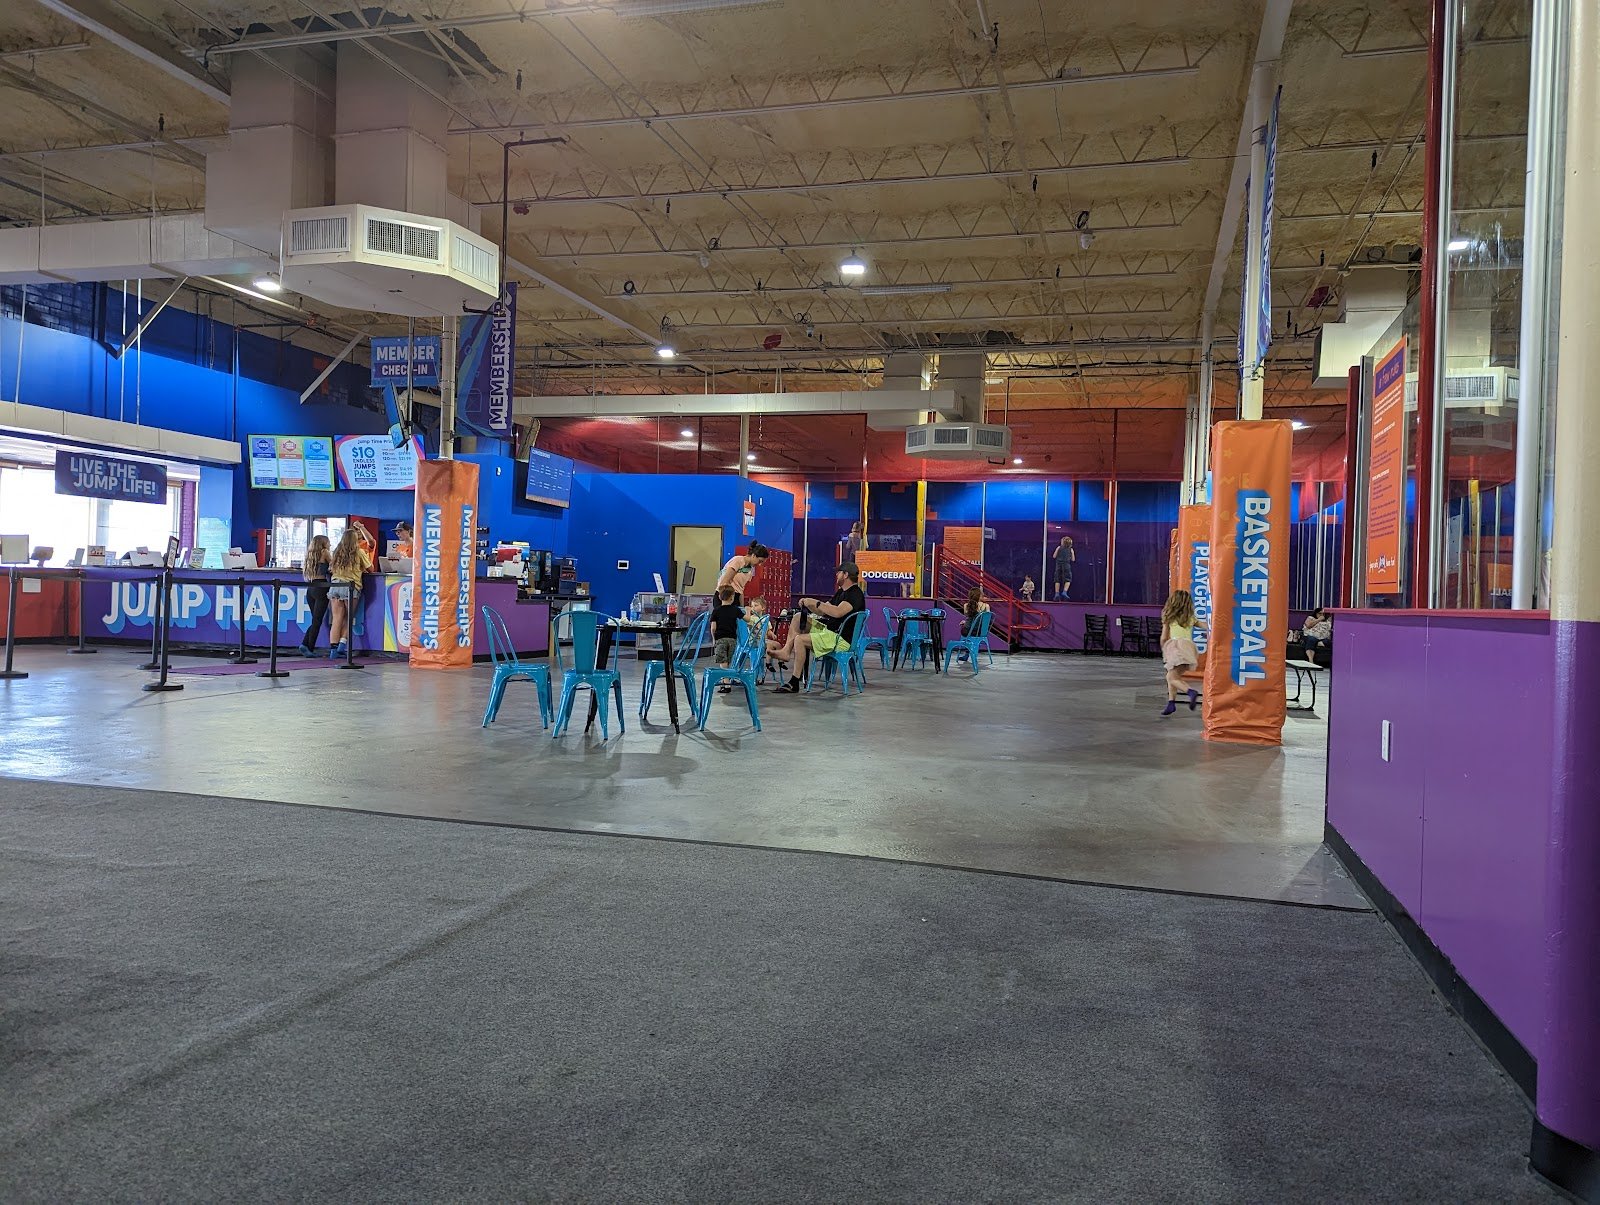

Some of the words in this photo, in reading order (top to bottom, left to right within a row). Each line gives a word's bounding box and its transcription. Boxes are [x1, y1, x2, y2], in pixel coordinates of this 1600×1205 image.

[381, 364, 428, 376] CHEC-IN
[489, 291, 512, 430] MEMBERSHIP
[70, 457, 104, 475] LIVE
[107, 462, 136, 479] THE
[352, 447, 375, 458] $10
[73, 472, 118, 490] JUMP
[122, 478, 156, 495] LIFE!
[423, 508, 442, 650] MEMBERSHIPS
[458, 509, 474, 648] MEMBERSHIPS
[862, 571, 914, 580] DODGEBALL
[1238, 497, 1271, 686] BASKETBALL
[102, 581, 205, 625] JUMP
[1193, 546, 1210, 655] PLAYGROND
